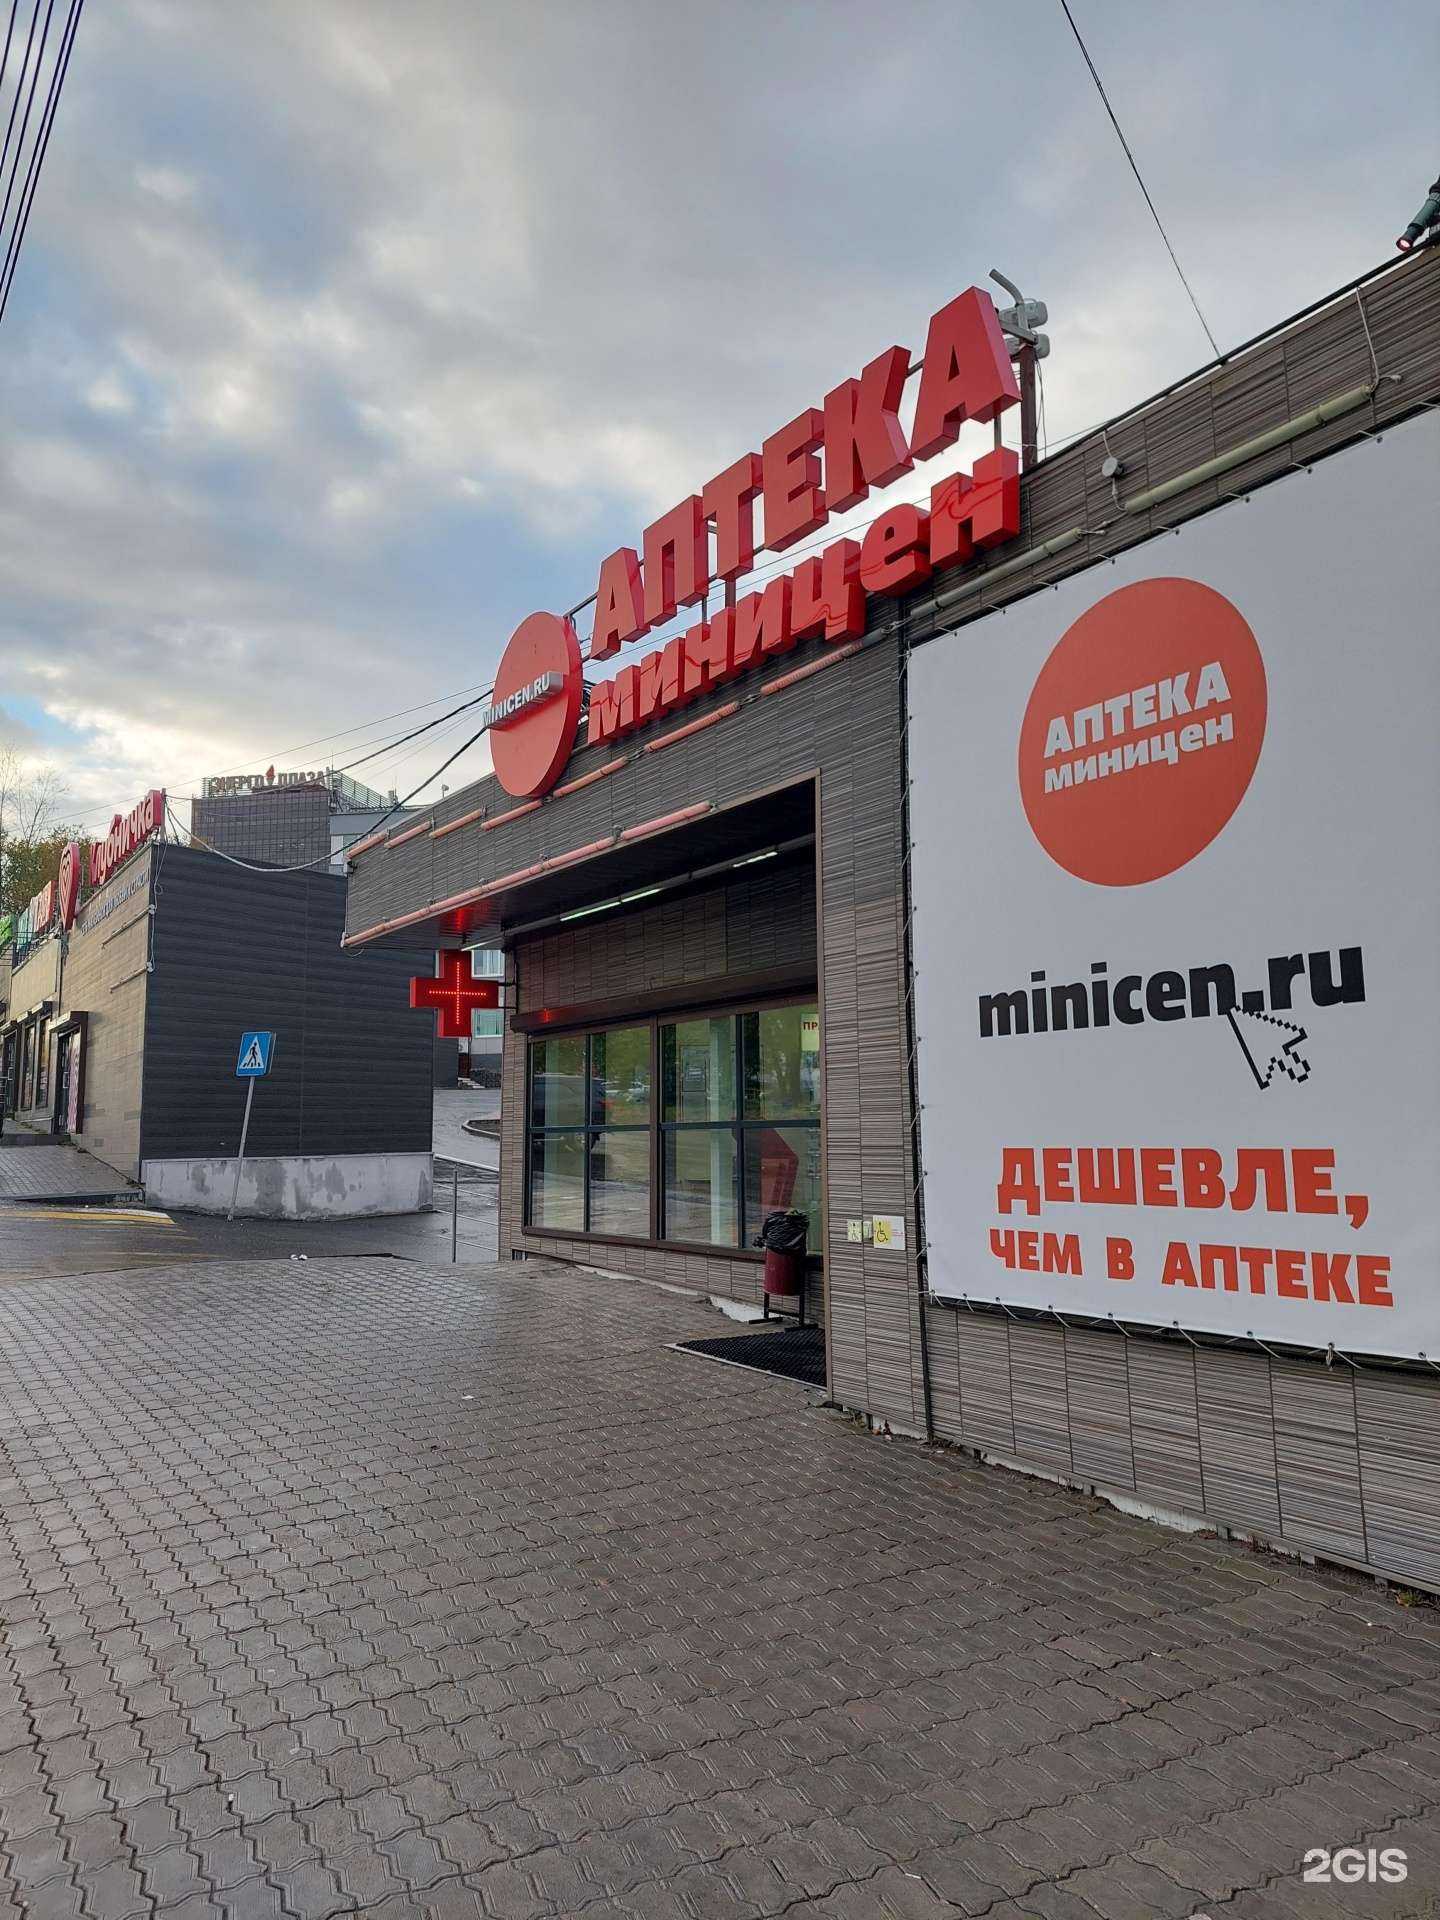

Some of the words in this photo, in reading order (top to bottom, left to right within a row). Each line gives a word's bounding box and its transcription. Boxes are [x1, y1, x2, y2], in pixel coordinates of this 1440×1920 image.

[591, 286, 1022, 661] АПТЕКА
[483, 671, 556, 727] MINICEN.RU
[1044, 661, 1231, 757] АПТЕКА
[1044, 713, 1234, 793] миницен
[978, 947, 1366, 1038] minicen.ru
[997, 1147, 1370, 1230] ДЕШЕВЛЕ,
[990, 1228, 1083, 1276] ЧЕМ
[1106, 1236, 1136, 1280] В
[1161, 1241, 1394, 1307] АПТЕКЕ
